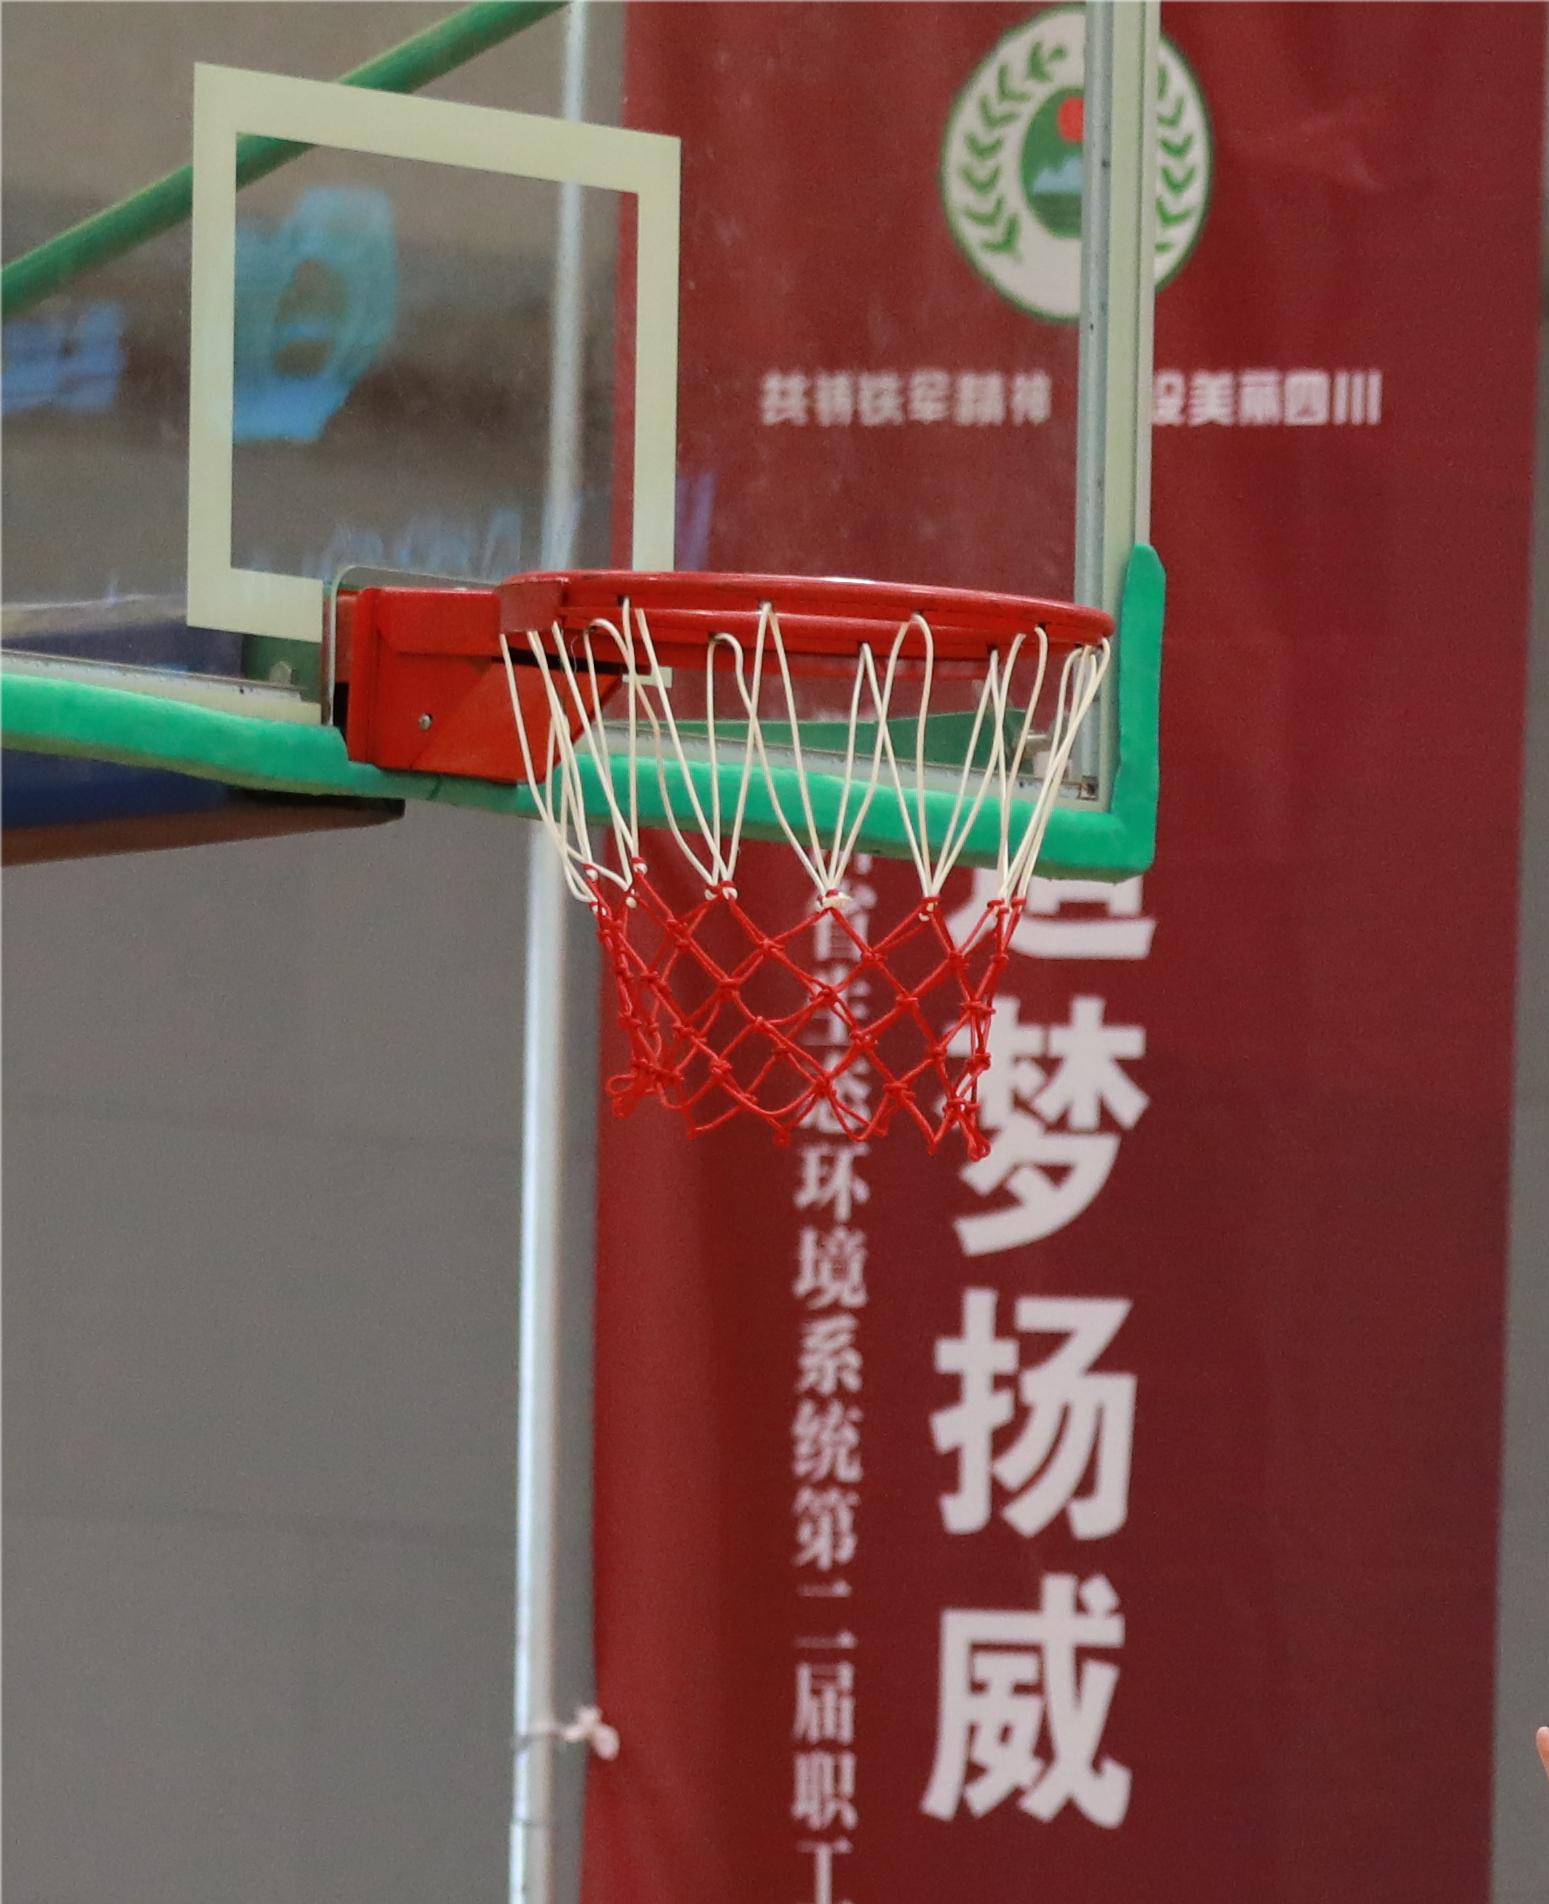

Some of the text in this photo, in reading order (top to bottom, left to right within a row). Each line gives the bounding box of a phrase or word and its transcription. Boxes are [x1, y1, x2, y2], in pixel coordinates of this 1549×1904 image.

[1152, 368, 1383, 427] 设美丽四川
